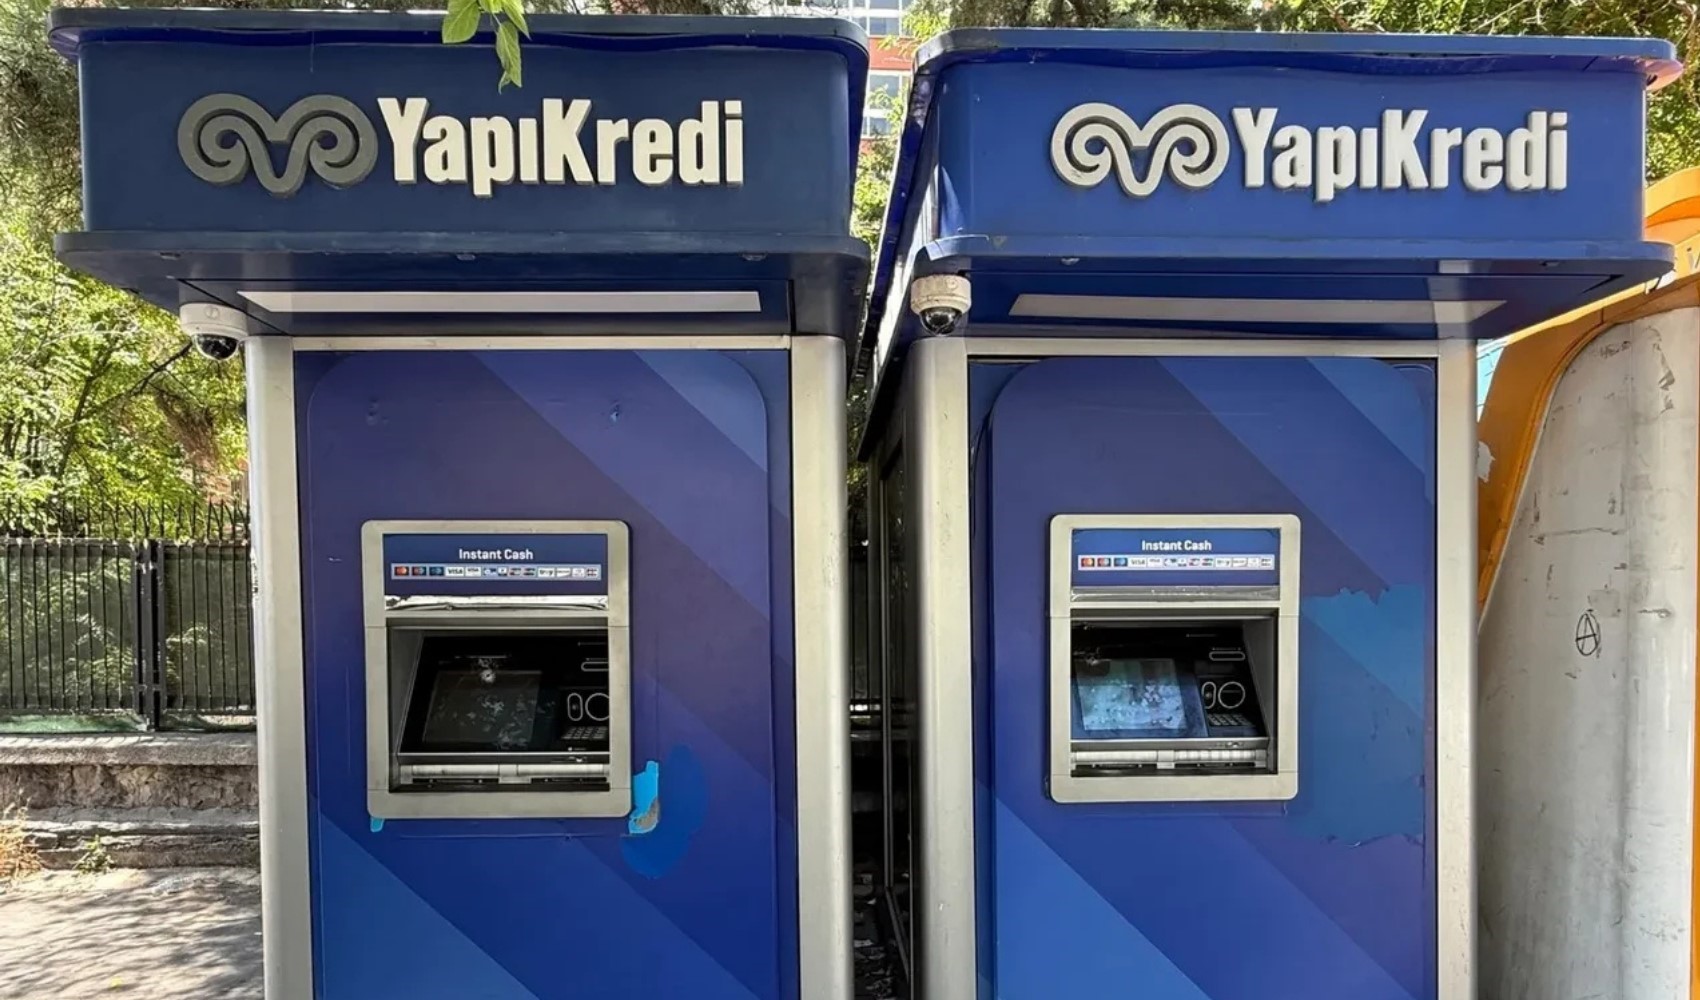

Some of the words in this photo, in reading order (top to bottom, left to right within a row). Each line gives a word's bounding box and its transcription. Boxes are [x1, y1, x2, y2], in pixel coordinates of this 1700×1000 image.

[1141, 540, 1182, 551] Instant
[1184, 540, 1212, 551] Cash
[458, 548, 502, 560] Instant
[504, 548, 534, 560] Cash
